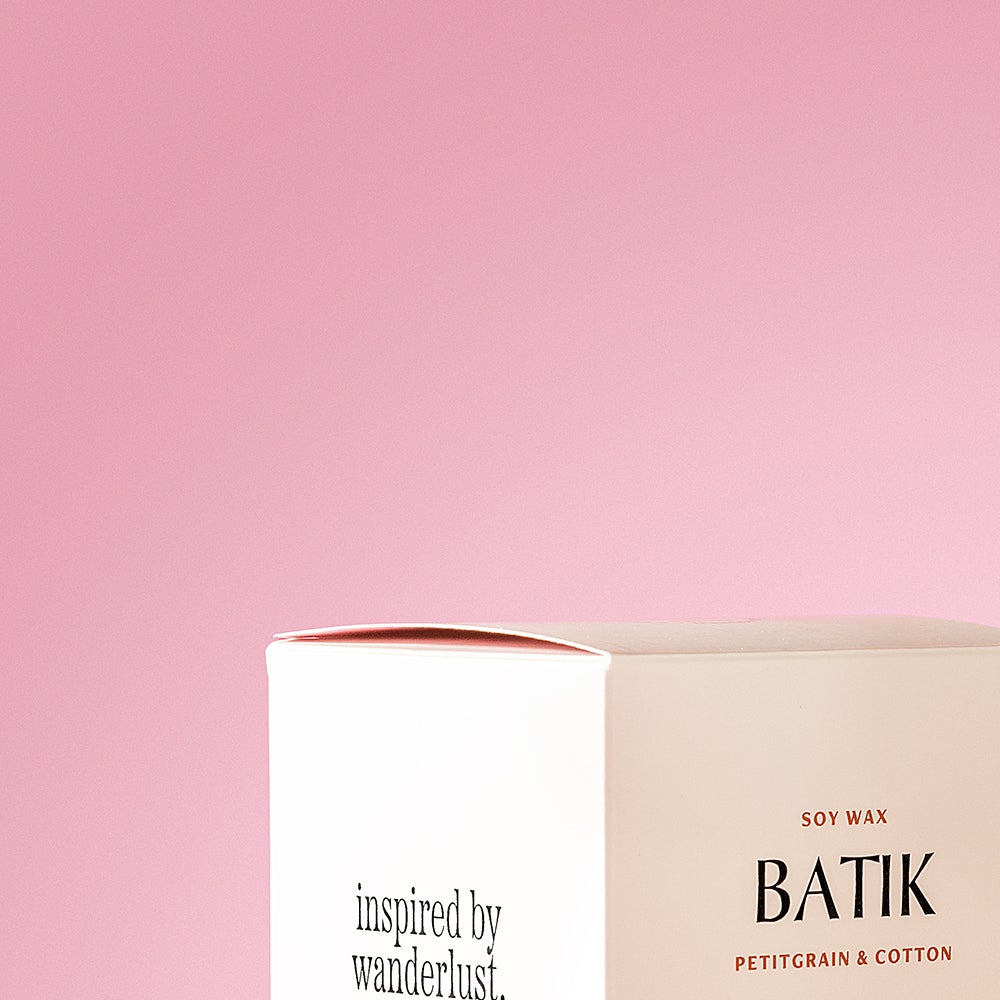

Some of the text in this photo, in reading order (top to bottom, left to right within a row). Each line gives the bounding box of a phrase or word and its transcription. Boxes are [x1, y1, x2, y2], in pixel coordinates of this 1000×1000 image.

[801, 809, 888, 827] SOY WAX
[756, 851, 937, 923] BATIK
[356, 882, 502, 956] inspired by
[735, 945, 952, 972] PETITGRAIN & COTTON
